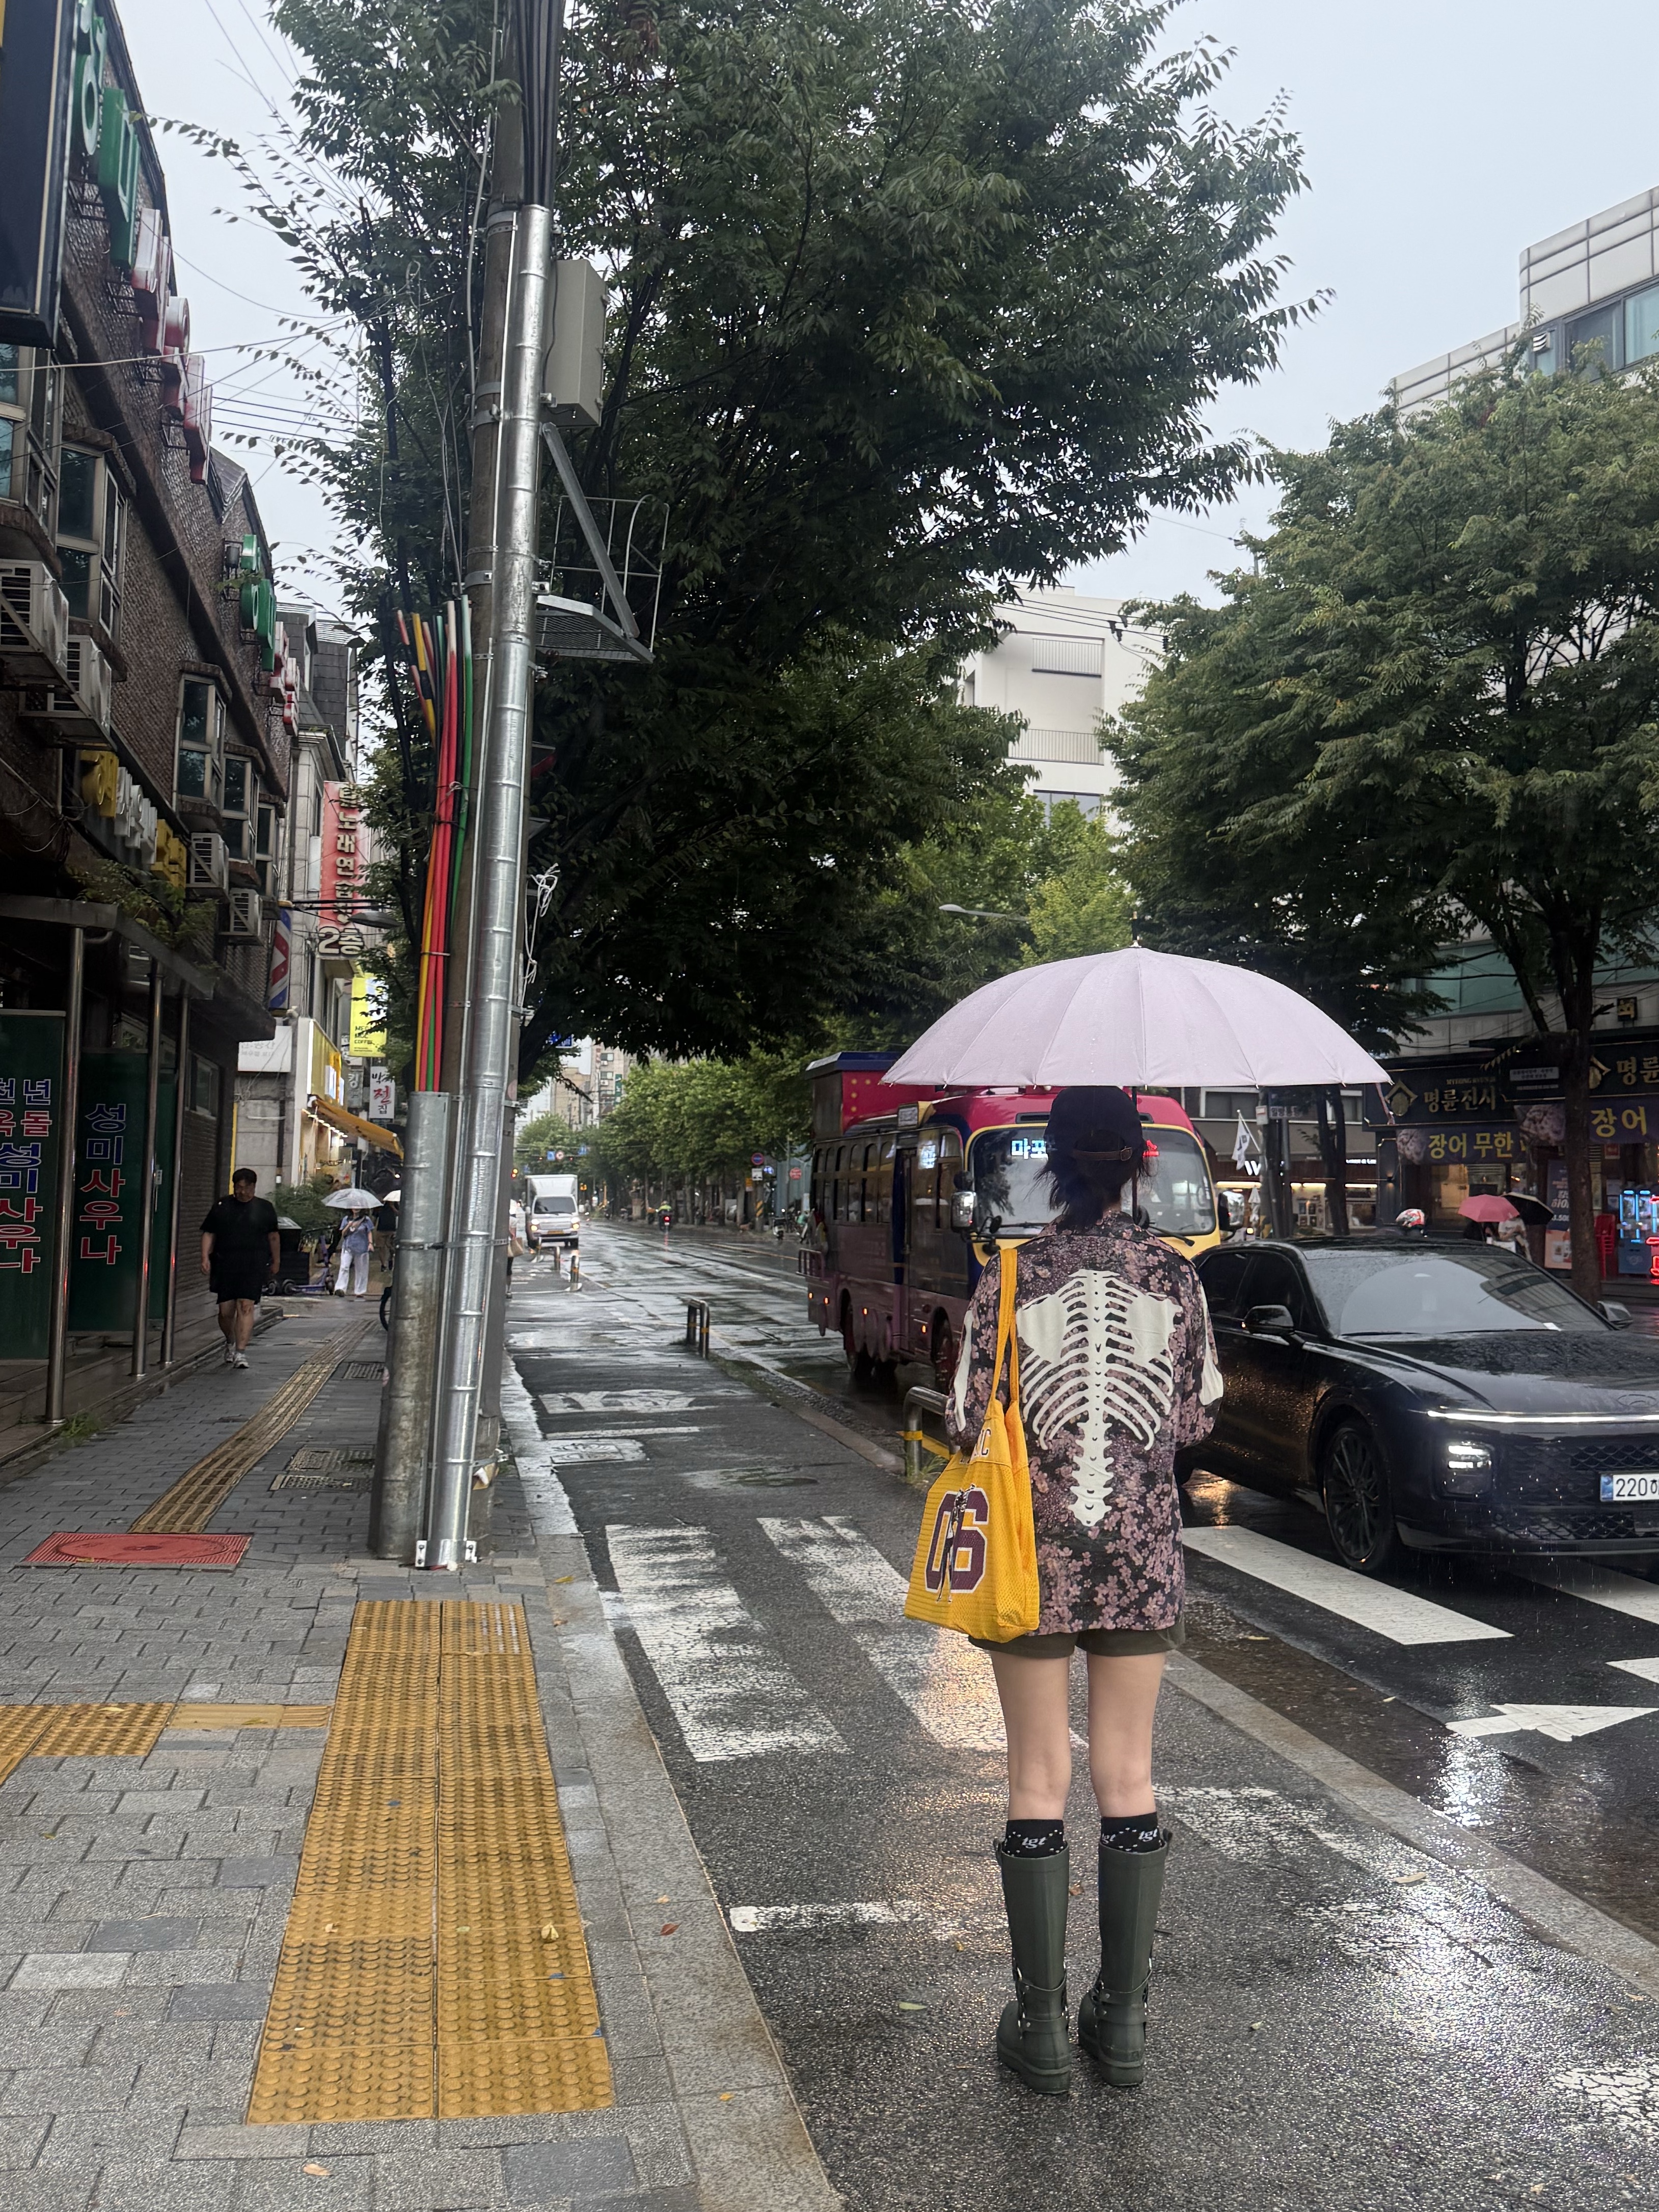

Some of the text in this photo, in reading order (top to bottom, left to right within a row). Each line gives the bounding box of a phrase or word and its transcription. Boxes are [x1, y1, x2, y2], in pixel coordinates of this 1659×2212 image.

[1590, 1106, 1647, 1138] 장어
[1428, 1133, 1467, 1159] 장어
[1473, 1131, 1513, 1159] 무한
[924, 1487, 990, 1594] 06
